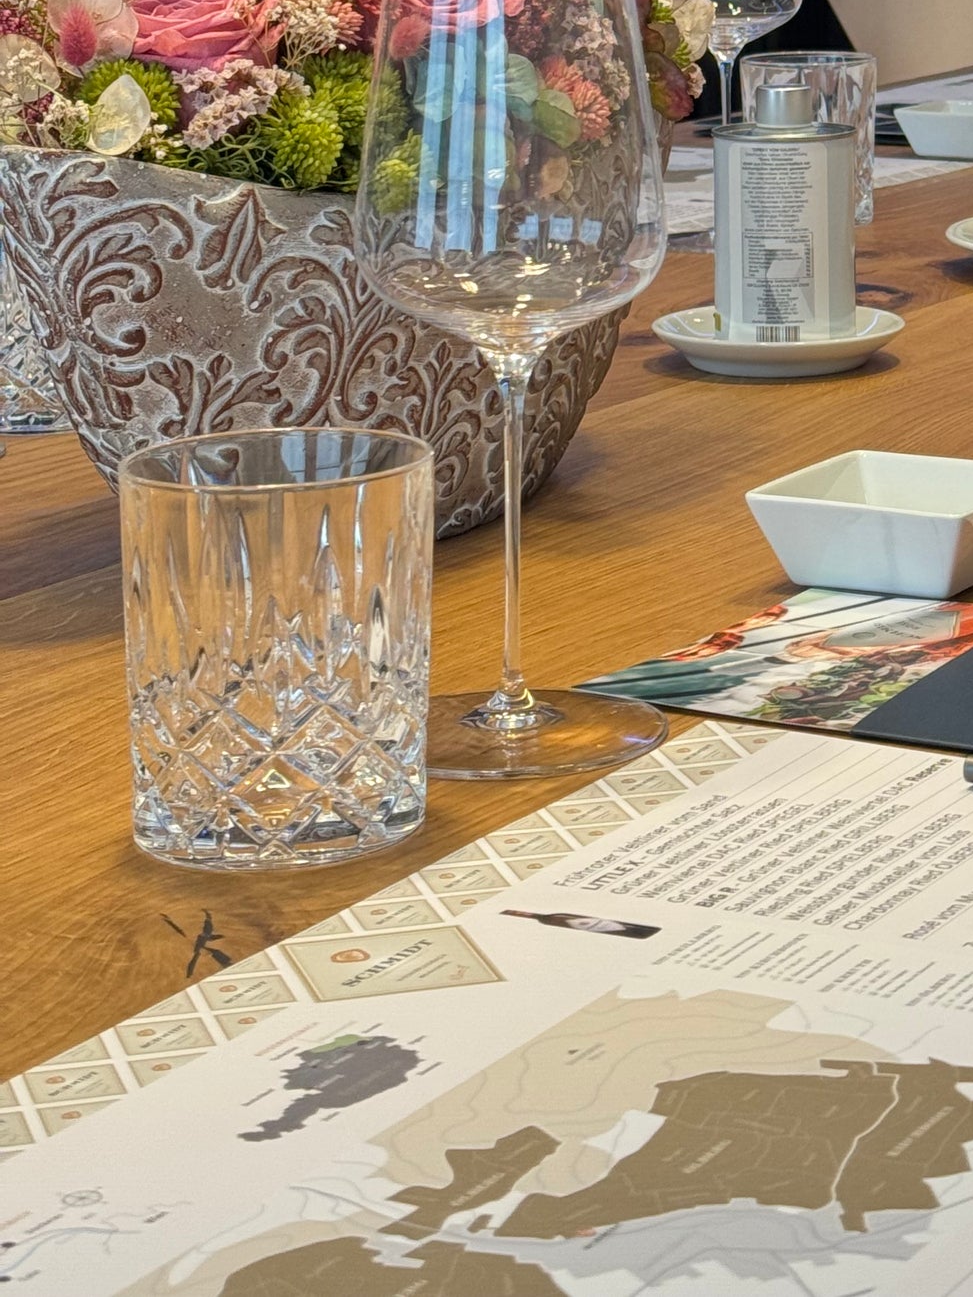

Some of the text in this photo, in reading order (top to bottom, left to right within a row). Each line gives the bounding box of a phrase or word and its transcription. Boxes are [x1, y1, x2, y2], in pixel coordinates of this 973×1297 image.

[552, 794, 728, 887] Frühroter Veltliner vom Sand
[580, 866, 634, 891] LITTLE
[645, 818, 718, 855] Gemischter
[710, 804, 745, 819] Satz
[610, 798, 788, 895] Grüner Veltliner Lössterrassen
[636, 803, 814, 899] Weinviertel DAC Ried SPIEGEL
[666, 799, 852, 904] Grüner Veltliner Ried SPIELBERG
[694, 893, 728, 908] BIG
[737, 857, 784, 883] Grüner
[776, 829, 831, 858] Veltliner
[824, 795, 892, 830] Weinviertel
[881, 781, 914, 796] DAC
[904, 758, 953, 782] Reserve
[723, 804, 910, 913] Sauvignon Blanc Ried GRILLBERG
[753, 835, 894, 917] Riesling Ried SPIELBERG
[782, 813, 962, 921] Weissburgunder Ried SPIELBERG
[812, 829, 971, 926] Gelber Muskateller vom Löss
[843, 886, 923, 931] Chardonnay
[908, 869, 944, 887] Ried
[901, 920, 941, 940] Rosé
[934, 903, 966, 920] vom
[341, 939, 433, 988] SCHMIDT
